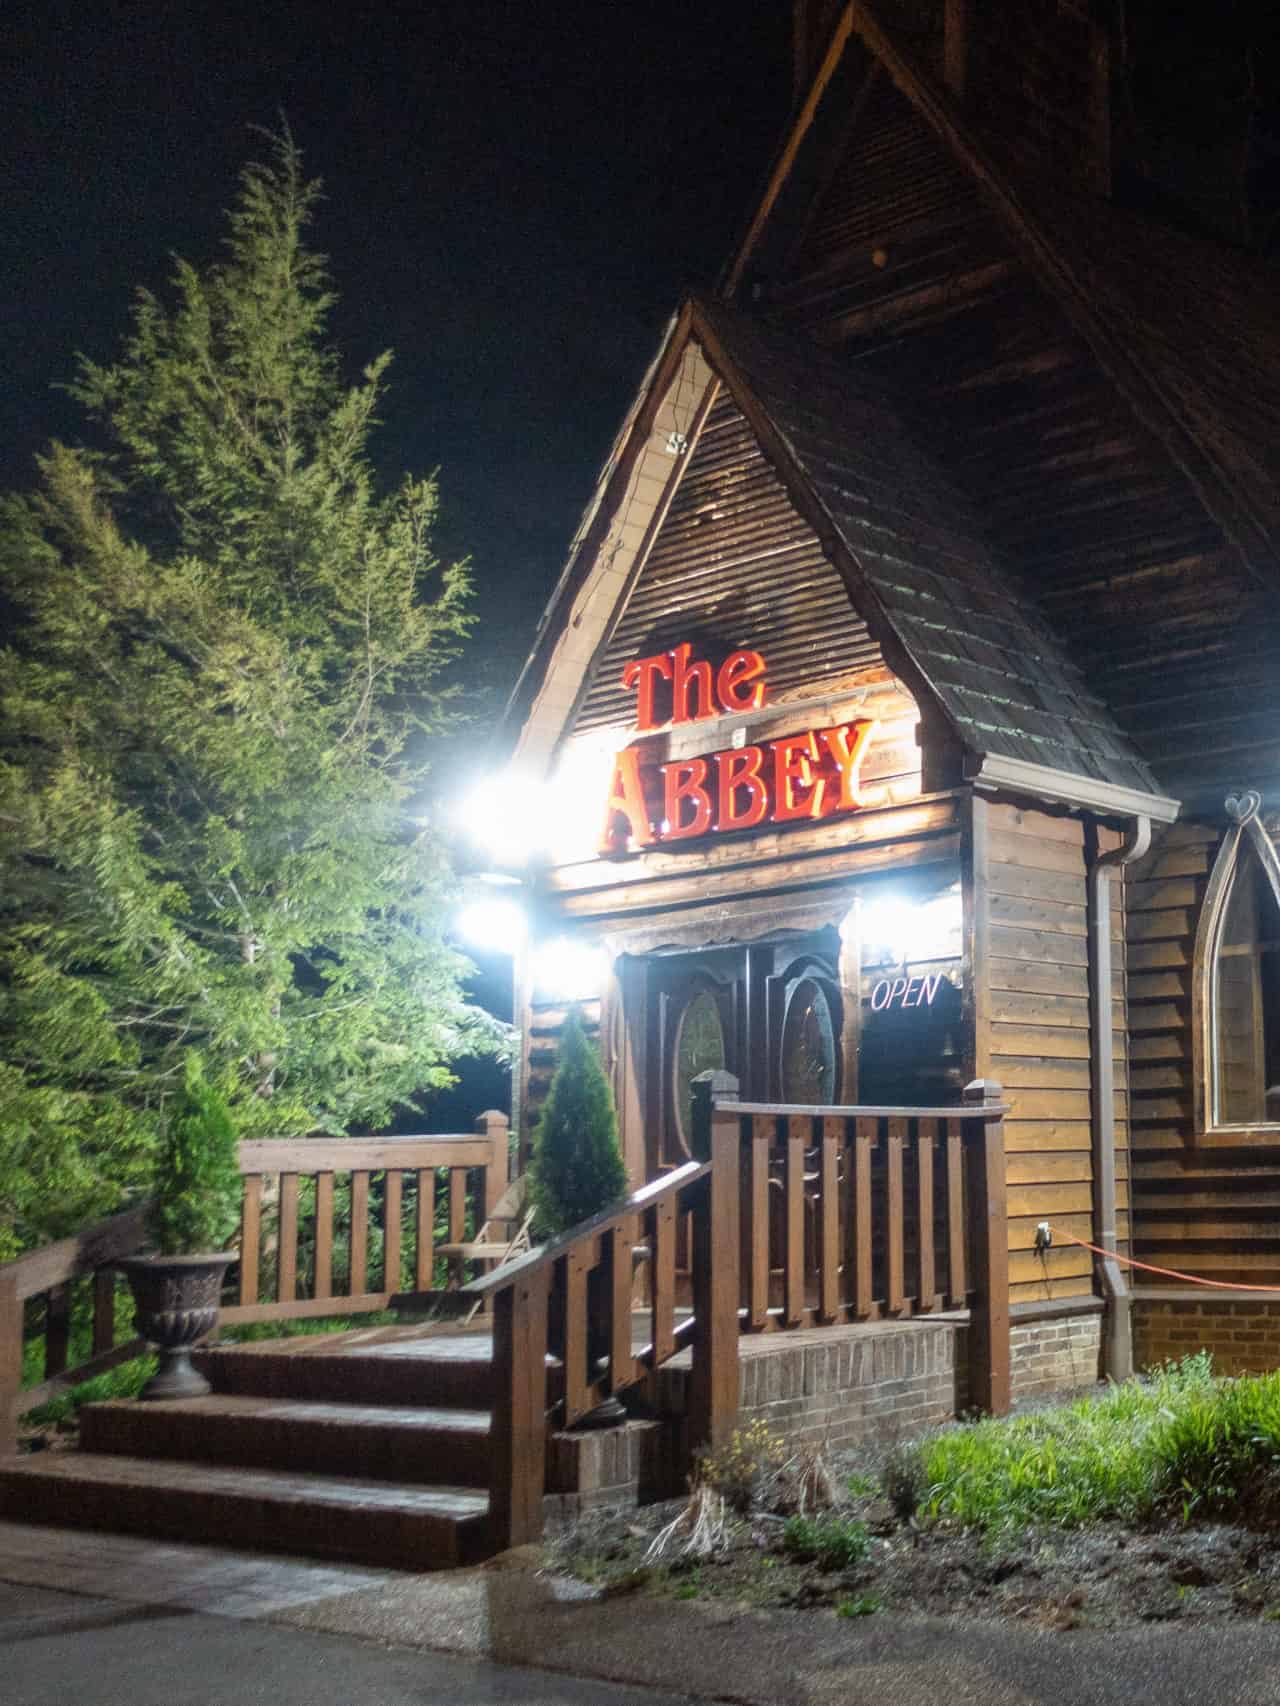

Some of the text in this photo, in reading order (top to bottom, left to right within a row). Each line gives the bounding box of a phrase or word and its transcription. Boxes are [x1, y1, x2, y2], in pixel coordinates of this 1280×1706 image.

[622, 641, 769, 732] The
[600, 718, 877, 854] ABBEY
[871, 971, 944, 1011] OPEN
